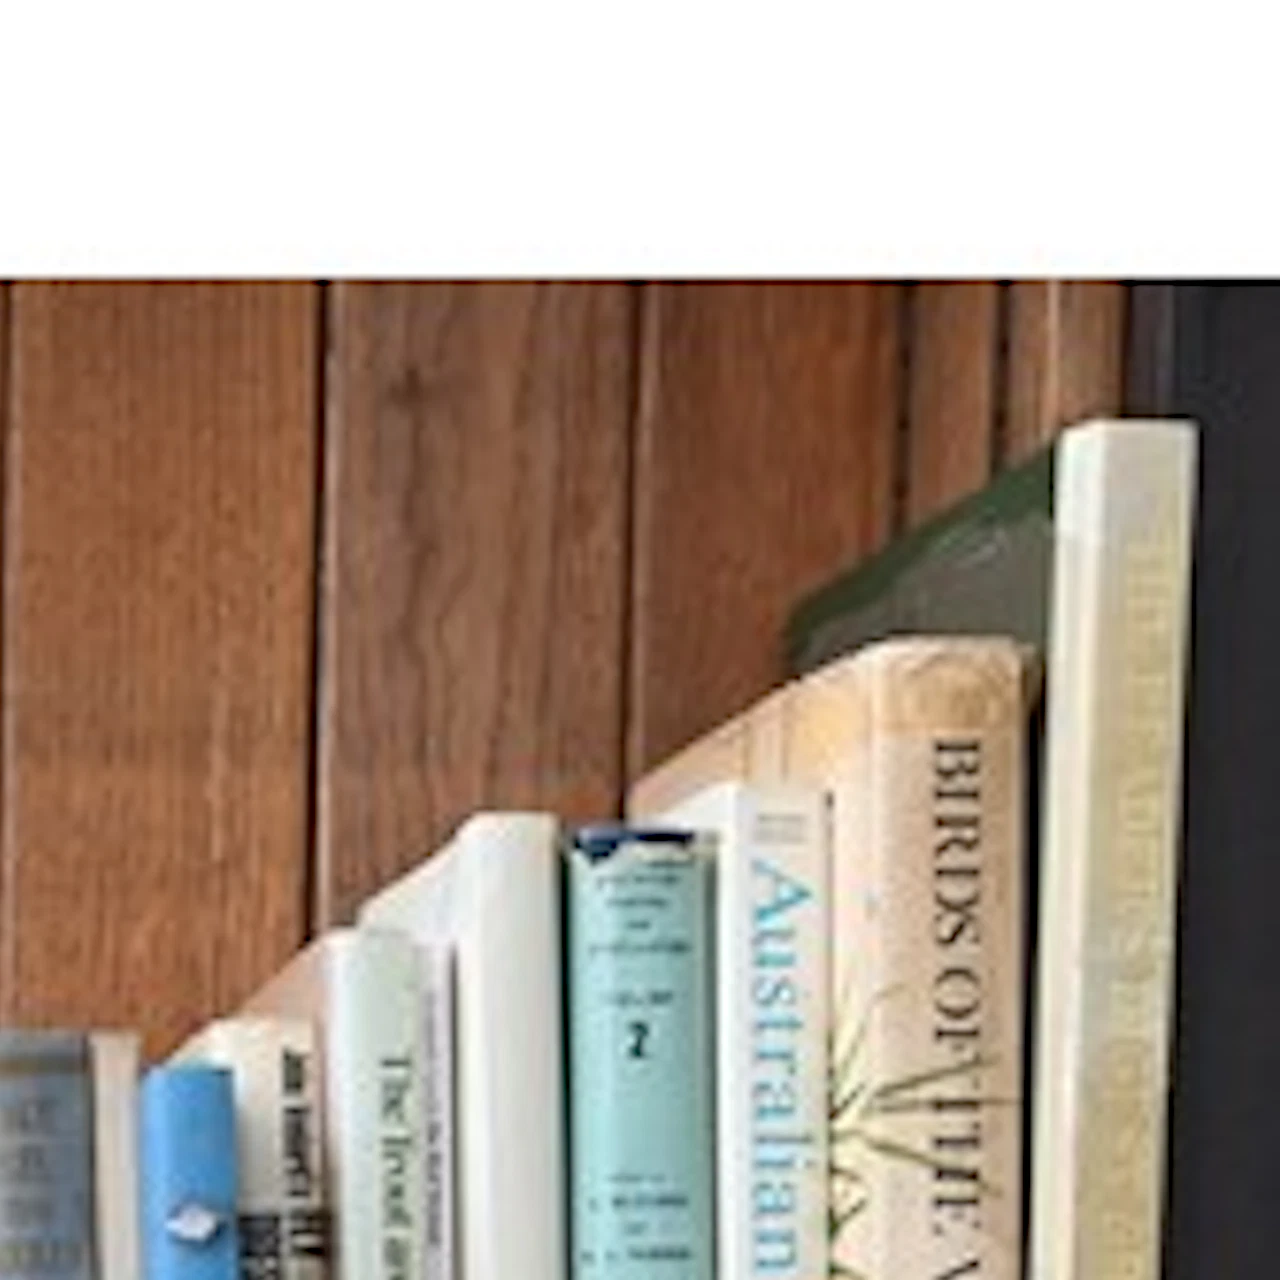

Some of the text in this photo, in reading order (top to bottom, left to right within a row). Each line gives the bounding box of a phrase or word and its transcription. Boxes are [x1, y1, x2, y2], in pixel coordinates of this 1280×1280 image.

[932, 736, 982, 946] BIRDS
[934, 966, 982, 1054] OF
[381, 1052, 415, 1124] The
[380, 1135, 416, 1229] Trout
[936, 1094, 986, 1234] THE
